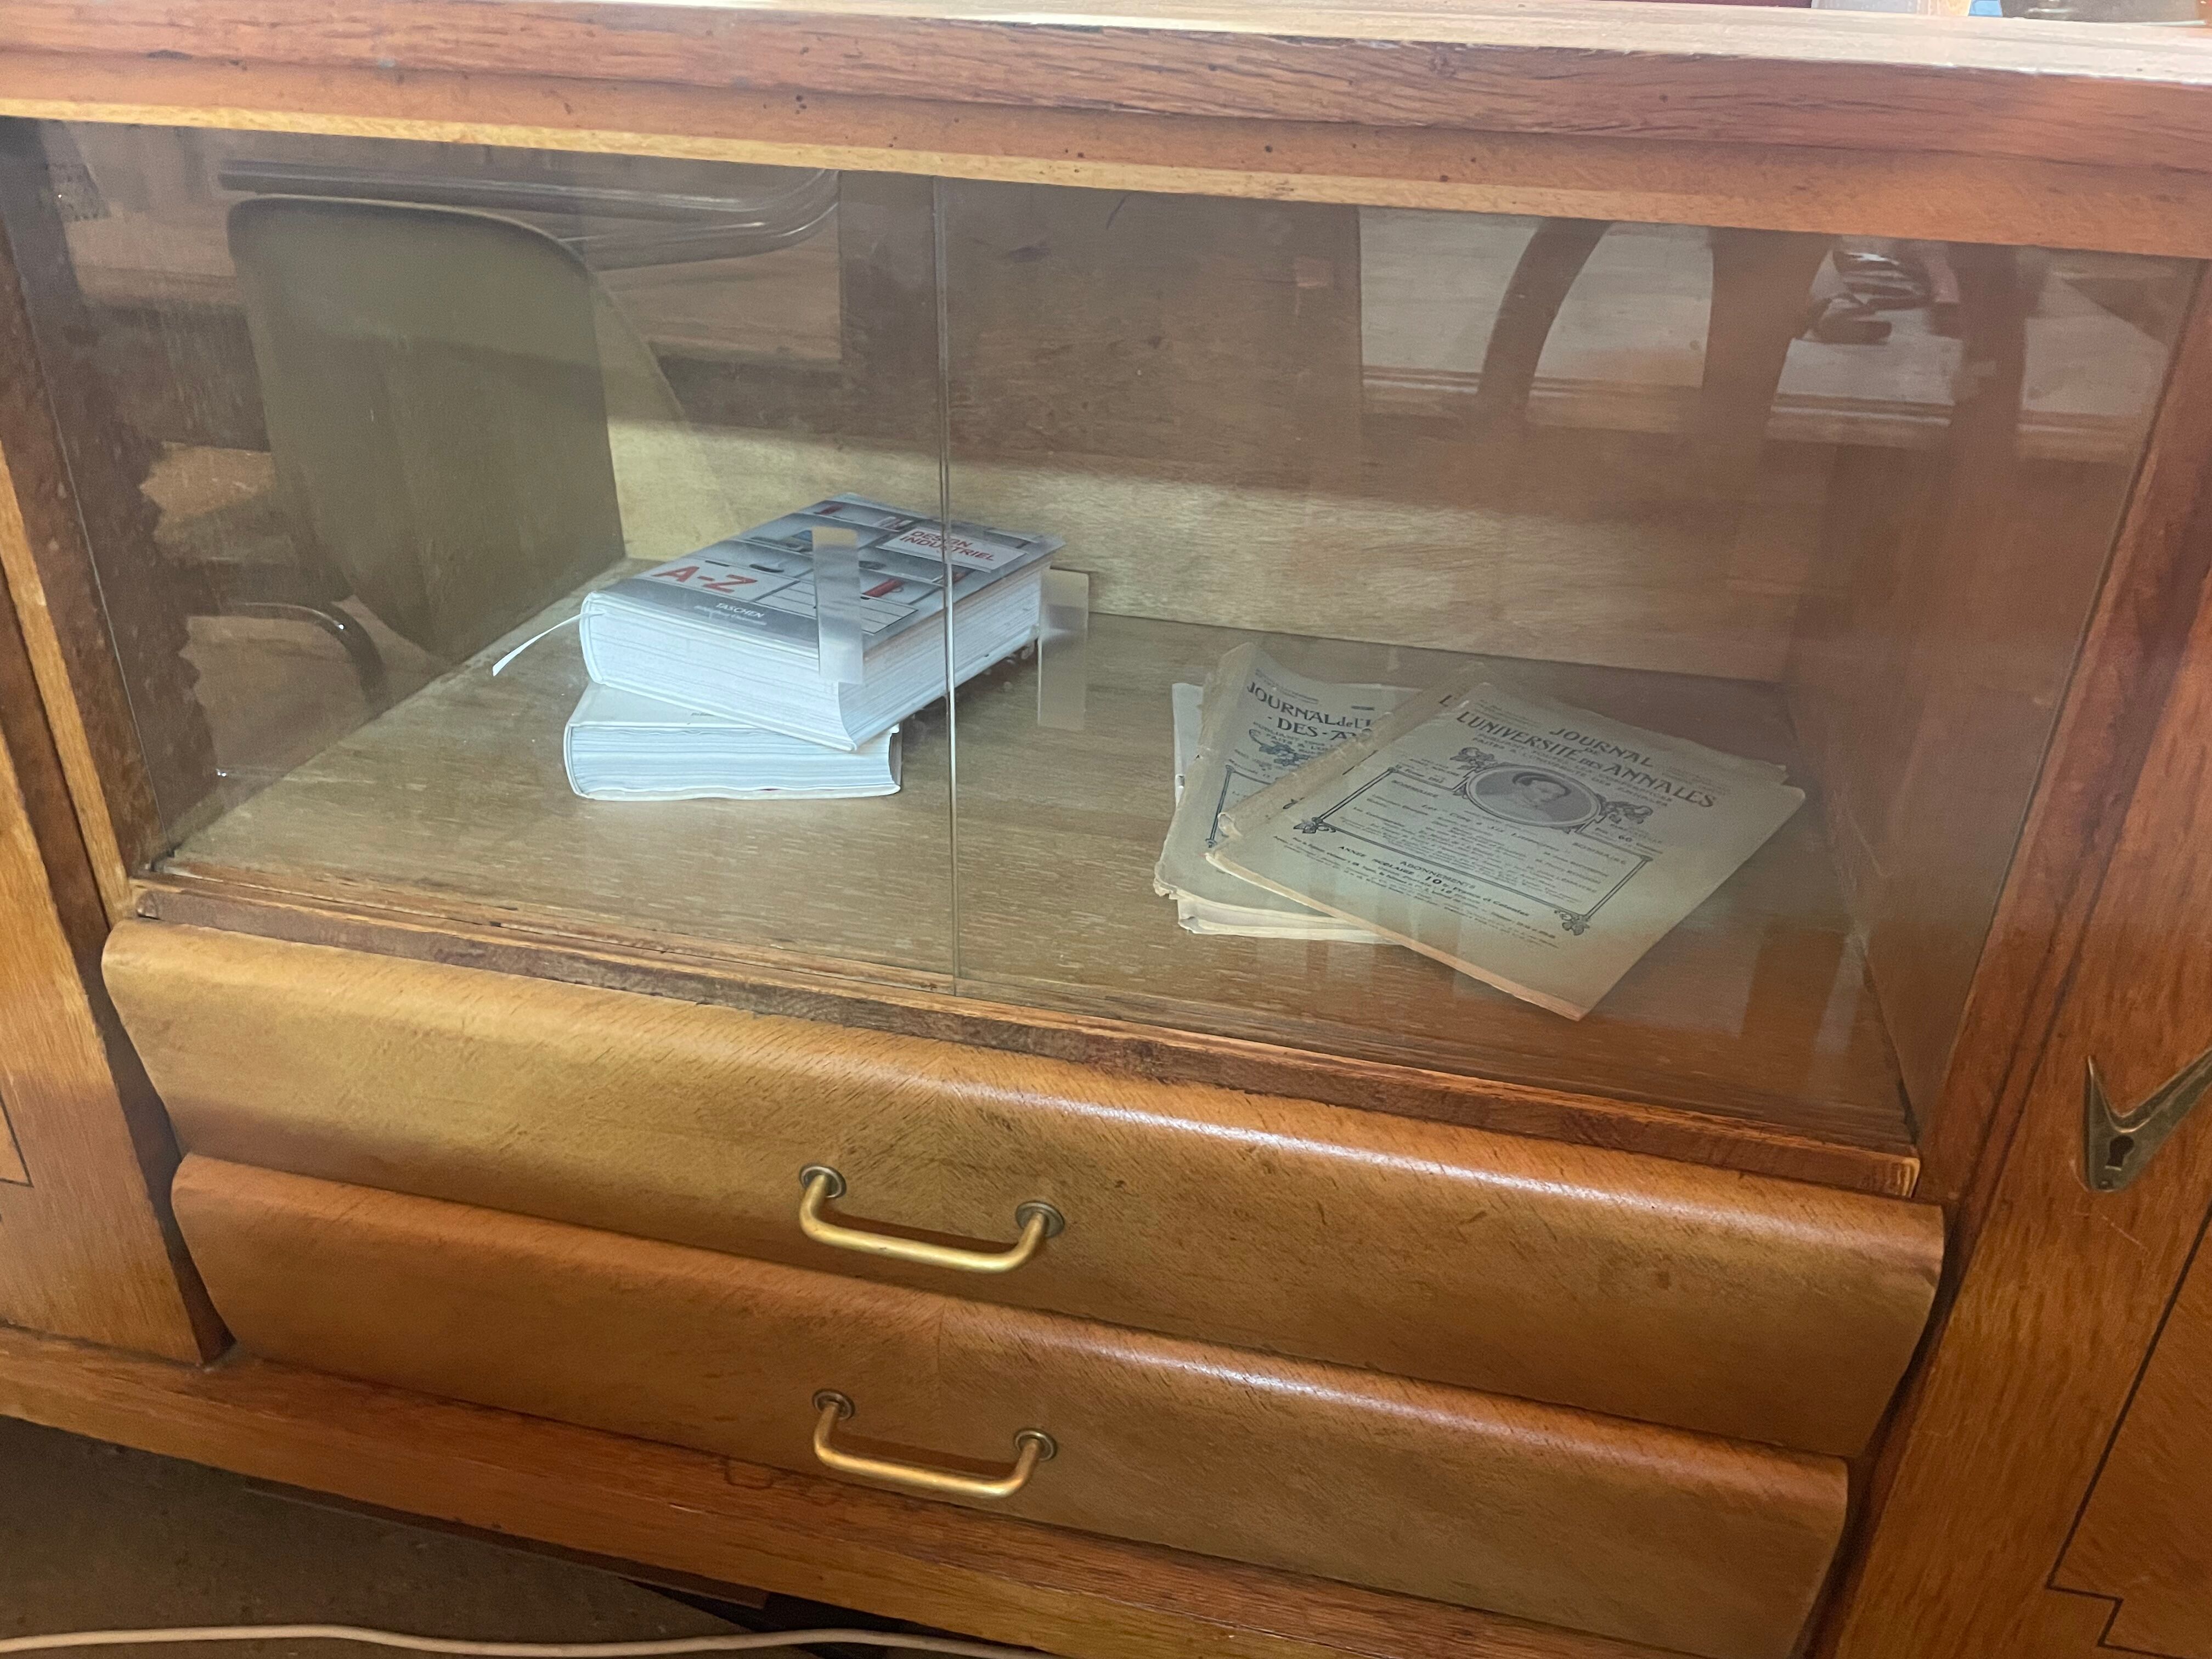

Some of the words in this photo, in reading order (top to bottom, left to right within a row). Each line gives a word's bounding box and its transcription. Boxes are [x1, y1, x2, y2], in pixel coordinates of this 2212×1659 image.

[911, 531, 974, 548] DESGN
[651, 566, 758, 593] A-Z
[715, 602, 764, 618] TASCHEN
[1247, 681, 1336, 726] JOURNAL
[1277, 716, 1318, 738] DES
[1549, 728, 1654, 768] JOURNAL
[1602, 763, 1717, 808] ANNALES
[1399, 860, 1476, 889] ABONNEMENTS
